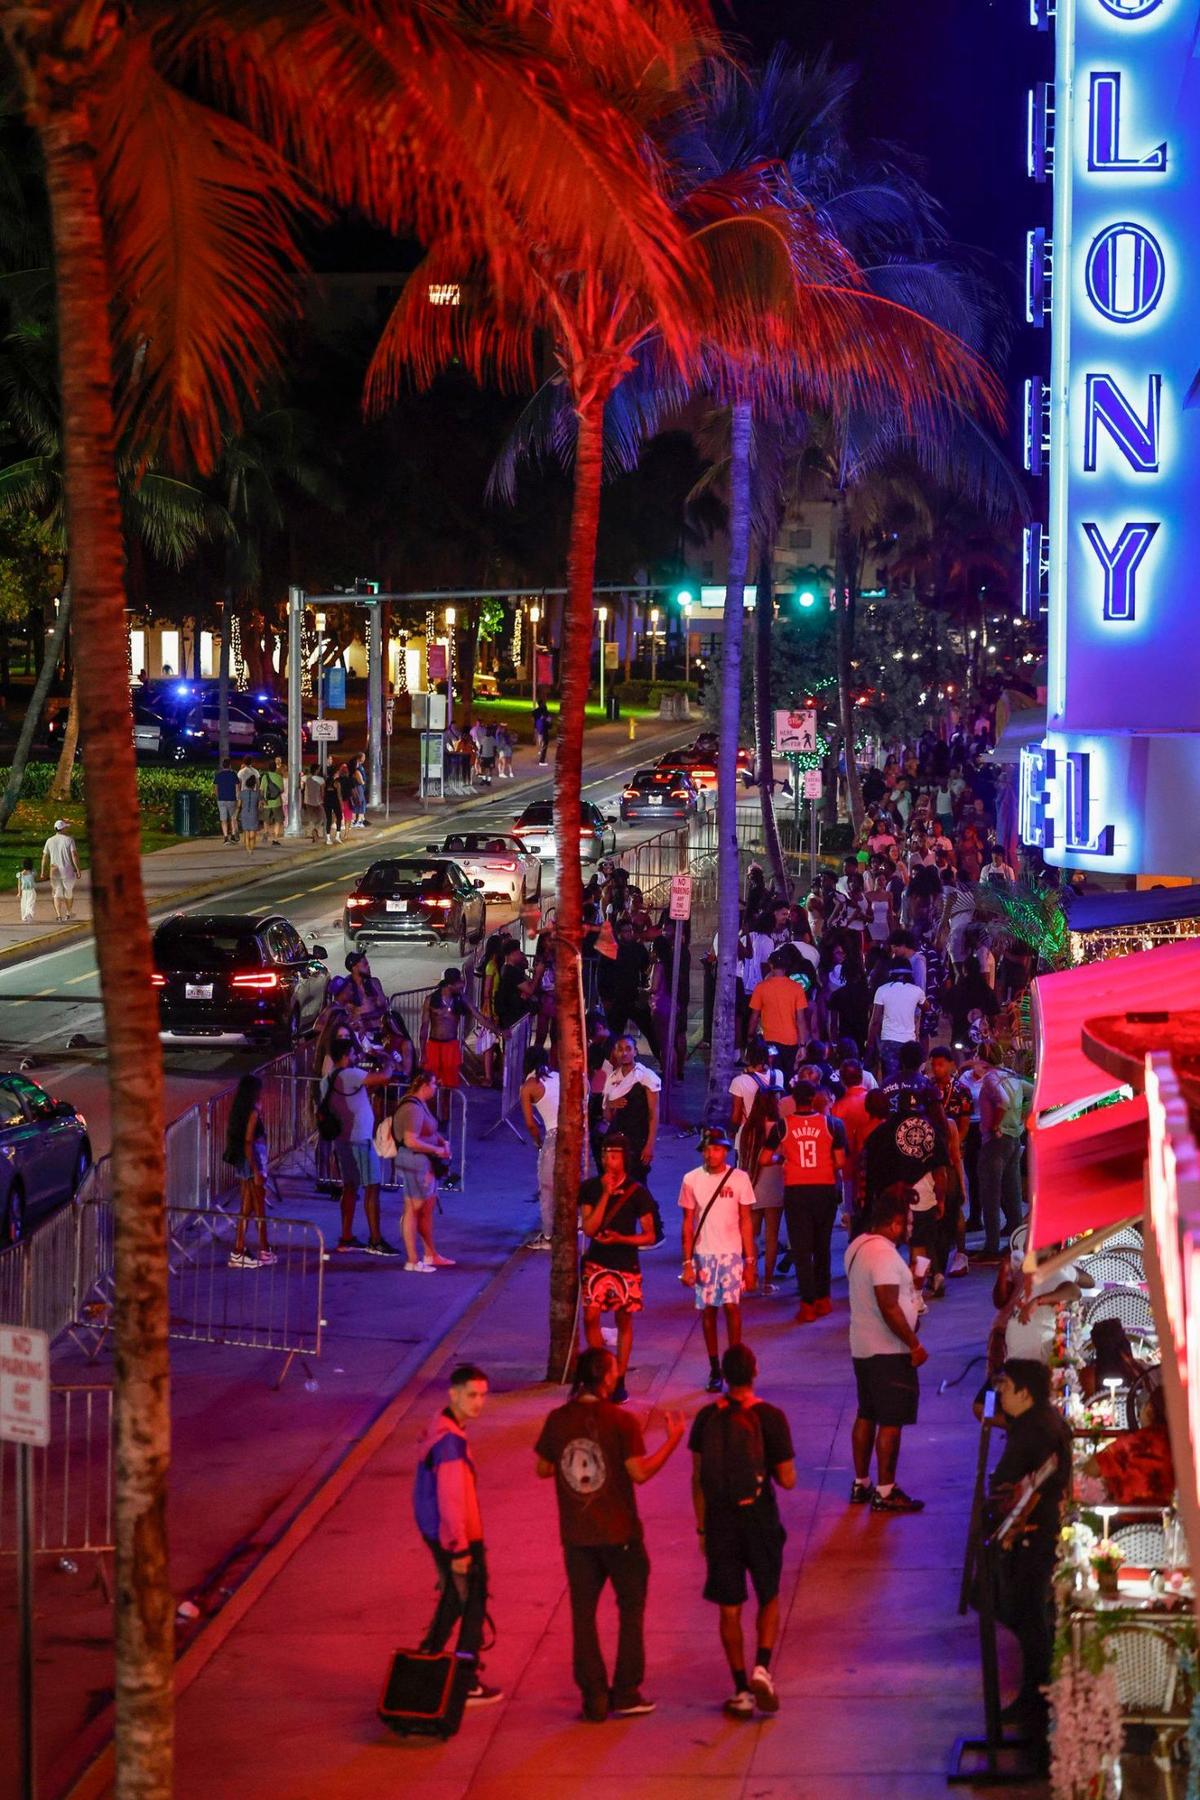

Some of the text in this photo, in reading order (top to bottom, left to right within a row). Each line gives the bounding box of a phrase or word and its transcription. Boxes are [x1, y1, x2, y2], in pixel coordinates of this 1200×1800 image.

[1082, 0, 1168, 621] LONY
[677, 878, 686, 887] NO
[797, 1140, 817, 1168] 13
